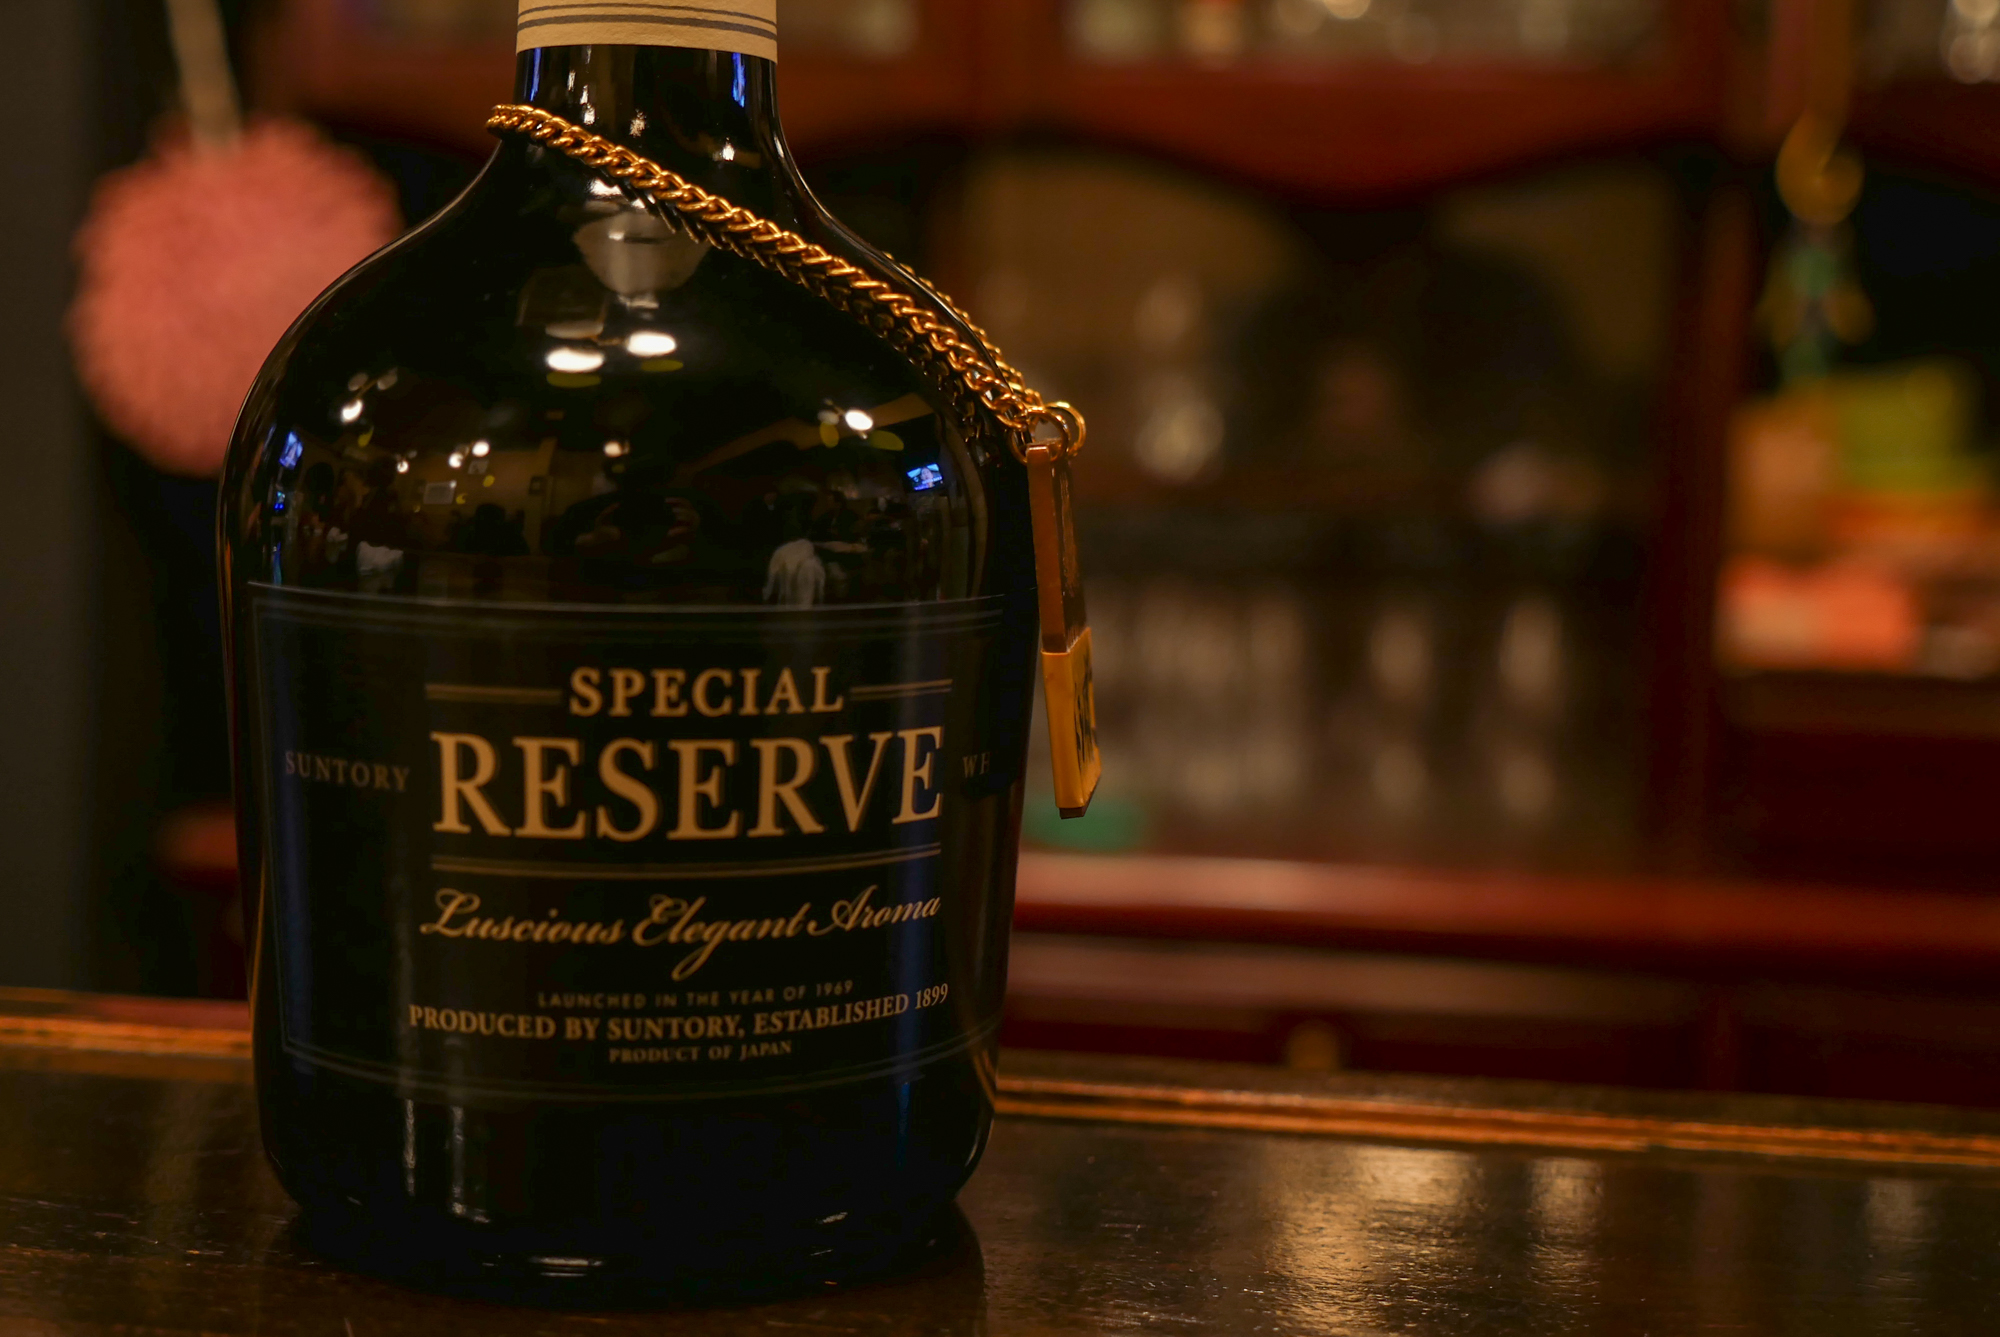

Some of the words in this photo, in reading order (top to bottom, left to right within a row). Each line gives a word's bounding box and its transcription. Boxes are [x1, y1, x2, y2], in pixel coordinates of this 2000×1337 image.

[568, 666, 845, 718] SPECIAL
[285, 750, 411, 793] SUNTORY
[429, 725, 945, 843] RESERVE
[418, 887, 626, 947] Luscious
[631, 893, 812, 982] Elegant
[805, 884, 942, 936] Aroma
[408, 1003, 557, 1041] PRODUCED
[564, 1015, 601, 1042] BY
[606, 1013, 746, 1042] SUNTORY,
[752, 992, 911, 1036] ESTABLISHED
[914, 982, 950, 1011] 1899
[537, 990, 647, 1010] LAUNCHED
[654, 992, 679, 1008] IN
[686, 990, 720, 1008] THE
[728, 986, 775, 1006] YEAR
[782, 984, 806, 1001] OF
[815, 979, 854, 998] 1969
[607, 1045, 701, 1064] PRODUCT
[707, 1044, 734, 1061] OF
[739, 1039, 793, 1063] JAPAN
